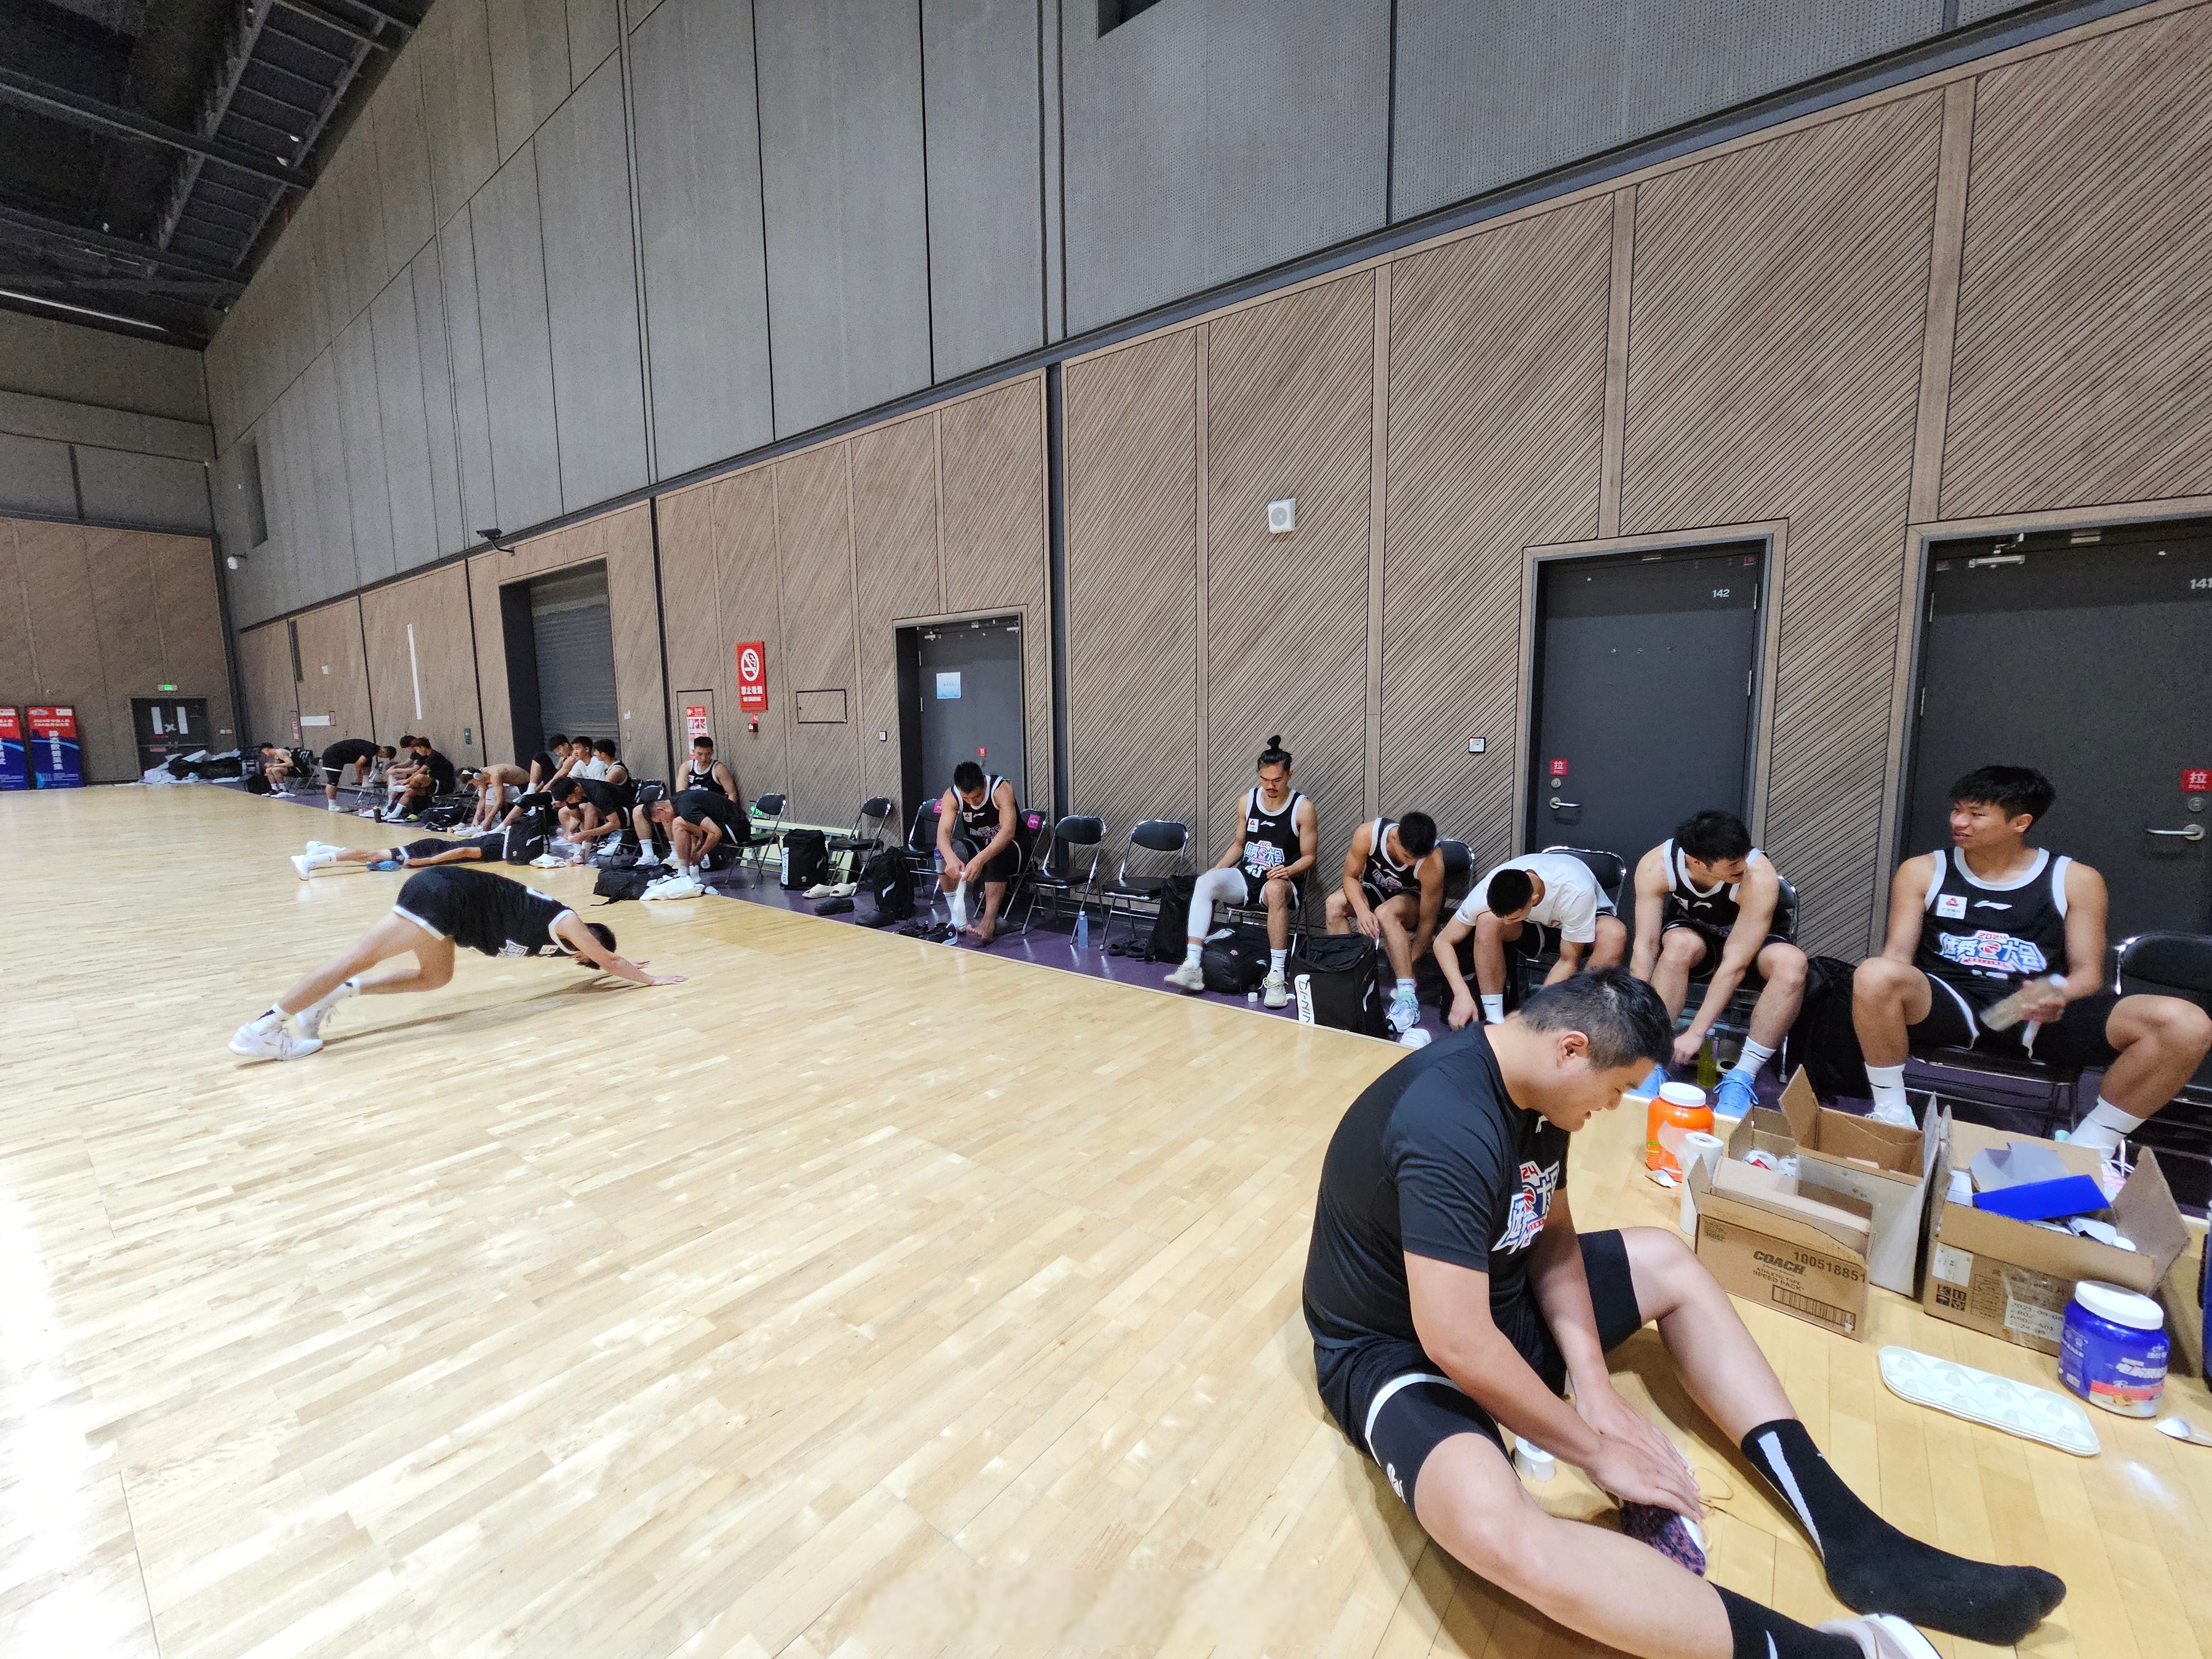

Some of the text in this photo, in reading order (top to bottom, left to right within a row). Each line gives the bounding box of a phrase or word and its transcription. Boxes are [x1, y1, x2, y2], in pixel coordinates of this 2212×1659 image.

[2190, 578, 2212, 589] 141
[1713, 589, 1730, 598] 142
[1554, 761, 1564, 769] 拉
[2189, 771, 2208, 784] 拉
[1298, 980, 1311, 1023] LI-NIN
[1753, 1250, 1806, 1275] COACH
[1753, 1270, 1778, 1284] SPEED
